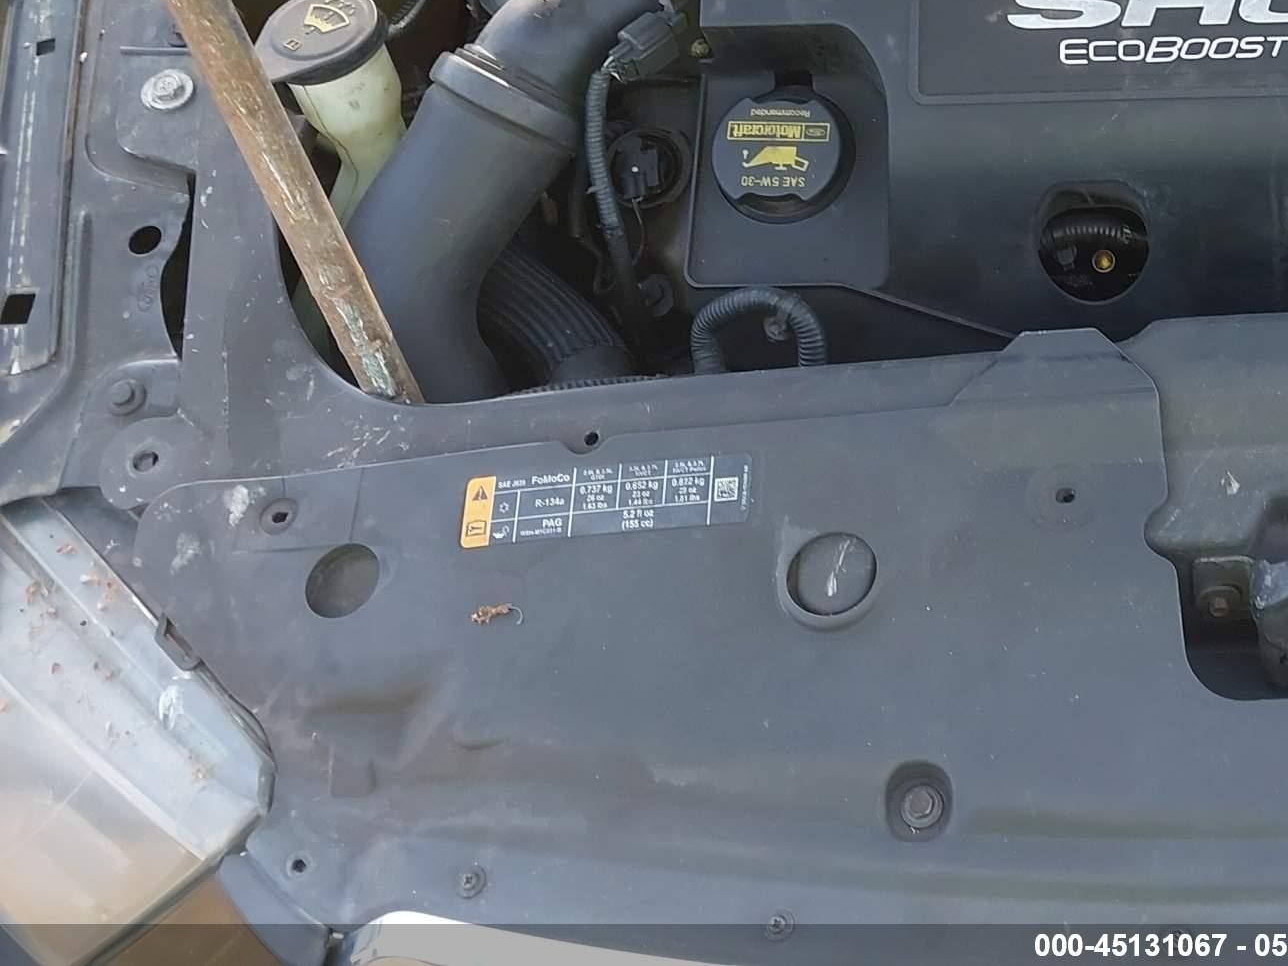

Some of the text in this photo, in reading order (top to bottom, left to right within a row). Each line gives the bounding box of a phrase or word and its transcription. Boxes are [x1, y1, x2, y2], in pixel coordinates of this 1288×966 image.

[750, 107, 811, 118] Recommended
[732, 123, 802, 138] Motorcraft
[741, 176, 806, 187] SAE 5W-30
[531, 473, 570, 485] FoMoCo
[695, 476, 705, 487] kg
[579, 484, 613, 495] 0.737 kg
[648, 480, 659, 491] kg
[535, 497, 565, 507] R-134a
[622, 509, 634, 519] 5.2
[542, 518, 562, 528] PAG
[621, 517, 654, 531] (155 cc)
